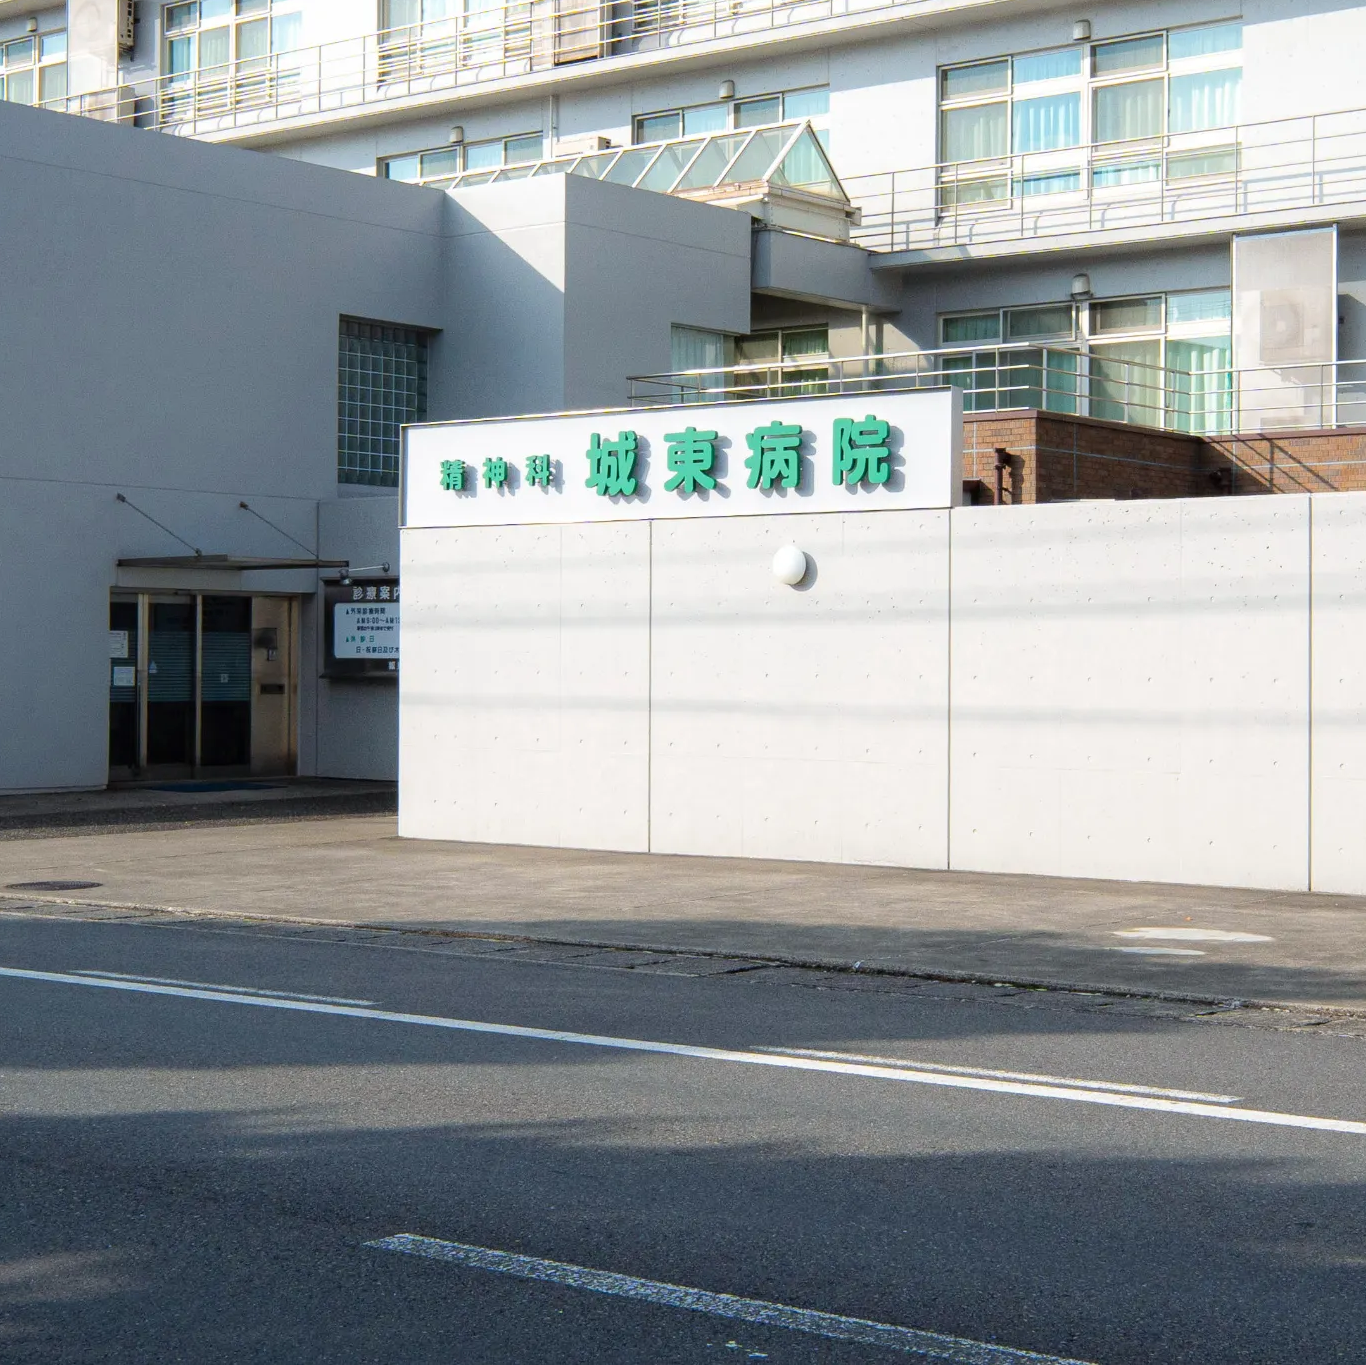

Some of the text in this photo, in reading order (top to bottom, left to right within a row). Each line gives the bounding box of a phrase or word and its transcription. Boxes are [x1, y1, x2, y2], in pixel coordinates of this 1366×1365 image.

[439, 414, 891, 497] 精神科 城東病院
